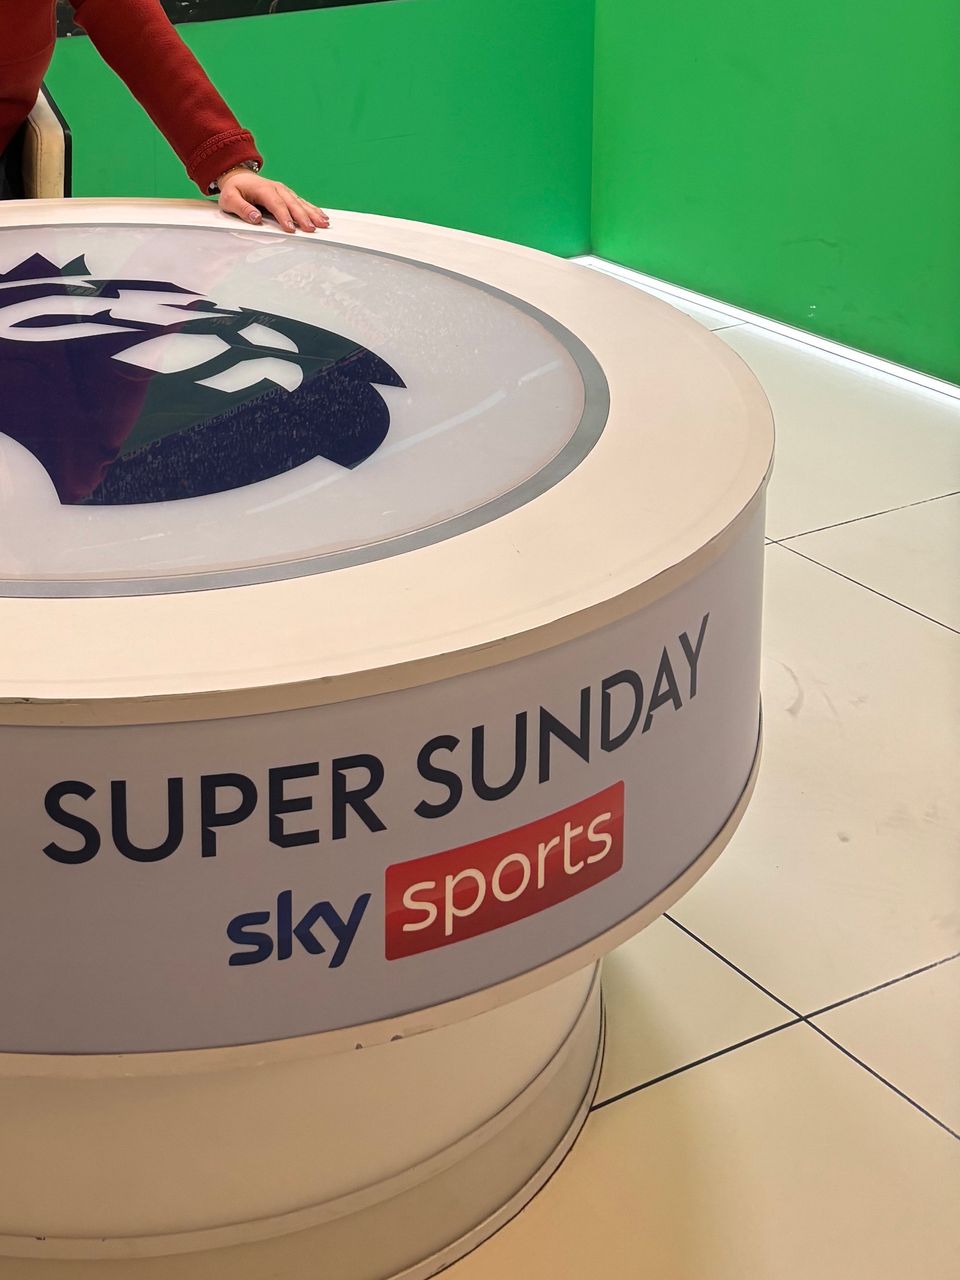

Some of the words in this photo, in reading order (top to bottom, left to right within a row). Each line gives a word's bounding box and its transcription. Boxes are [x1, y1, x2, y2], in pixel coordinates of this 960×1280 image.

[41, 753, 388, 866] SUPER
[413, 611, 711, 820] SUNDAY
[226, 889, 373, 969] sky
[400, 808, 614, 937] sports
